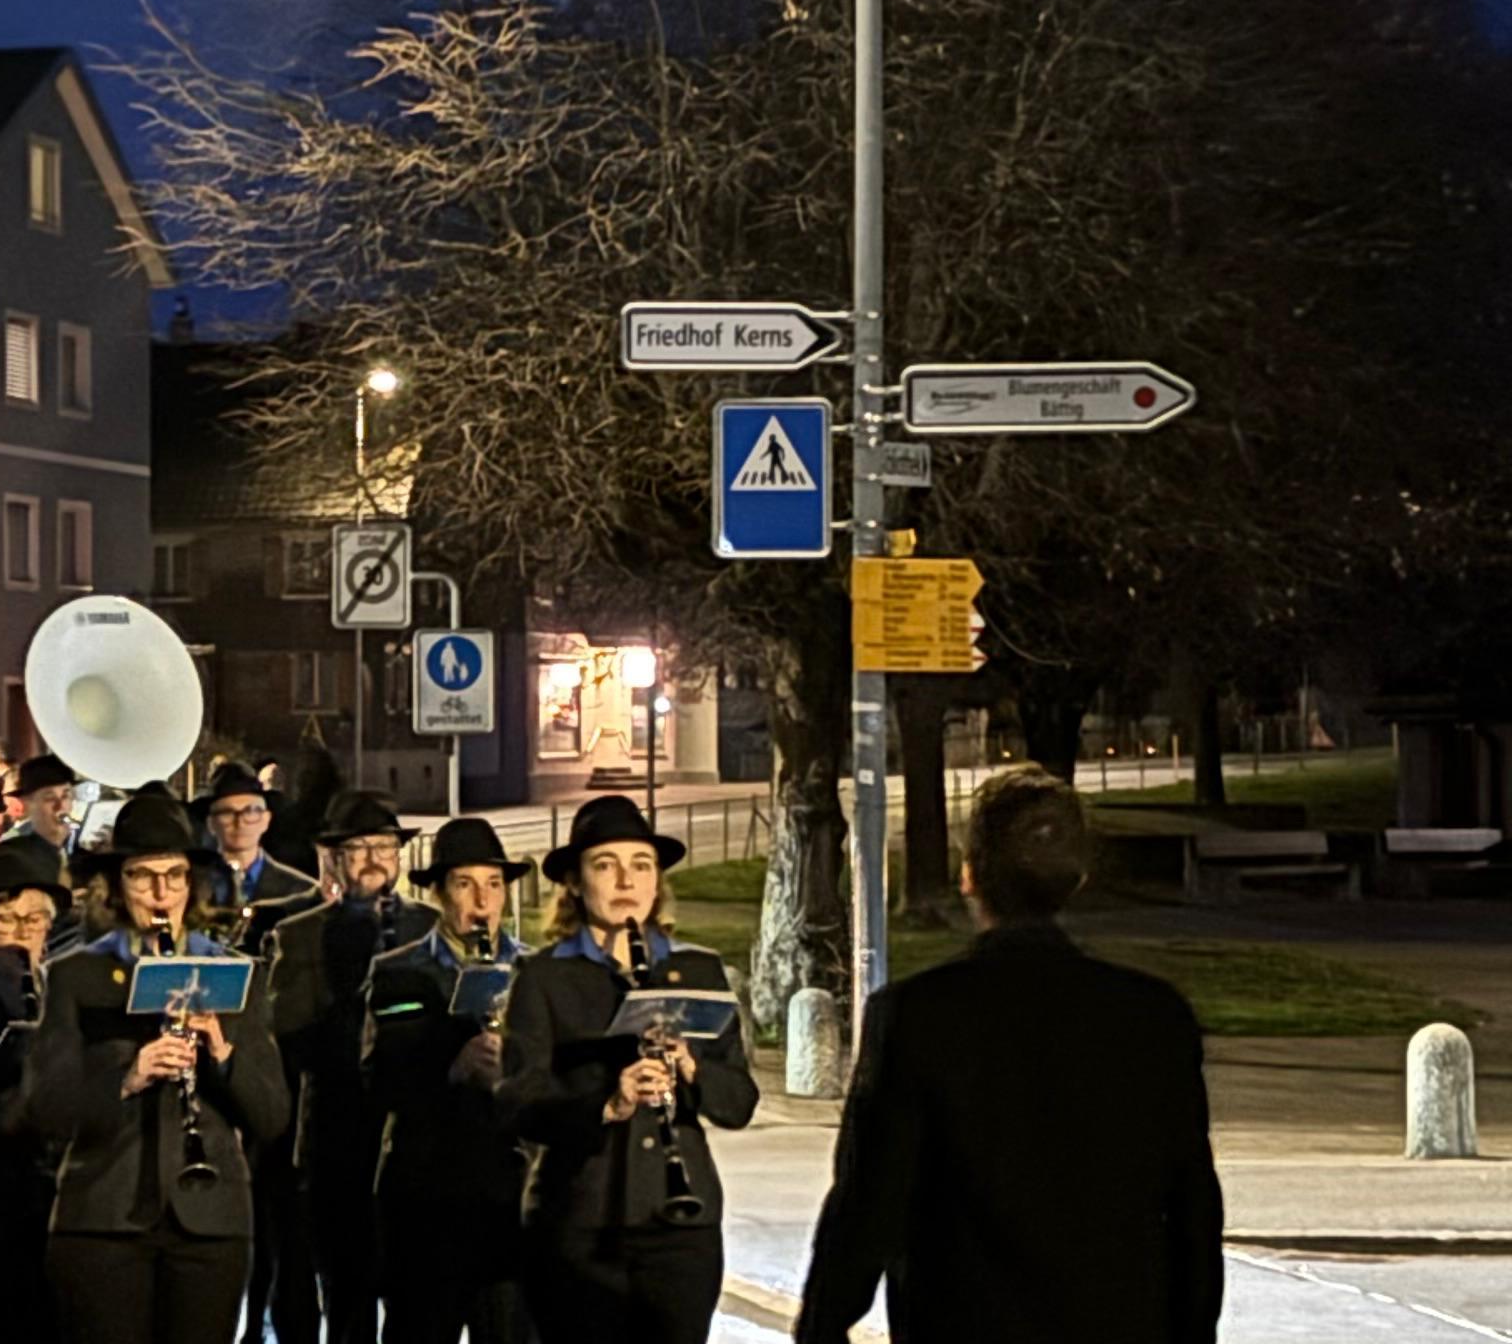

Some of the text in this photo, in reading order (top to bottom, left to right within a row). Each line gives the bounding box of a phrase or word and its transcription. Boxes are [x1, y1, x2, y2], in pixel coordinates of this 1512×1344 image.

[636, 322, 793, 349] Friedhof Kerns
[1008, 377, 1122, 398] Blumengeschäft
[426, 713, 482, 727] gestattet
